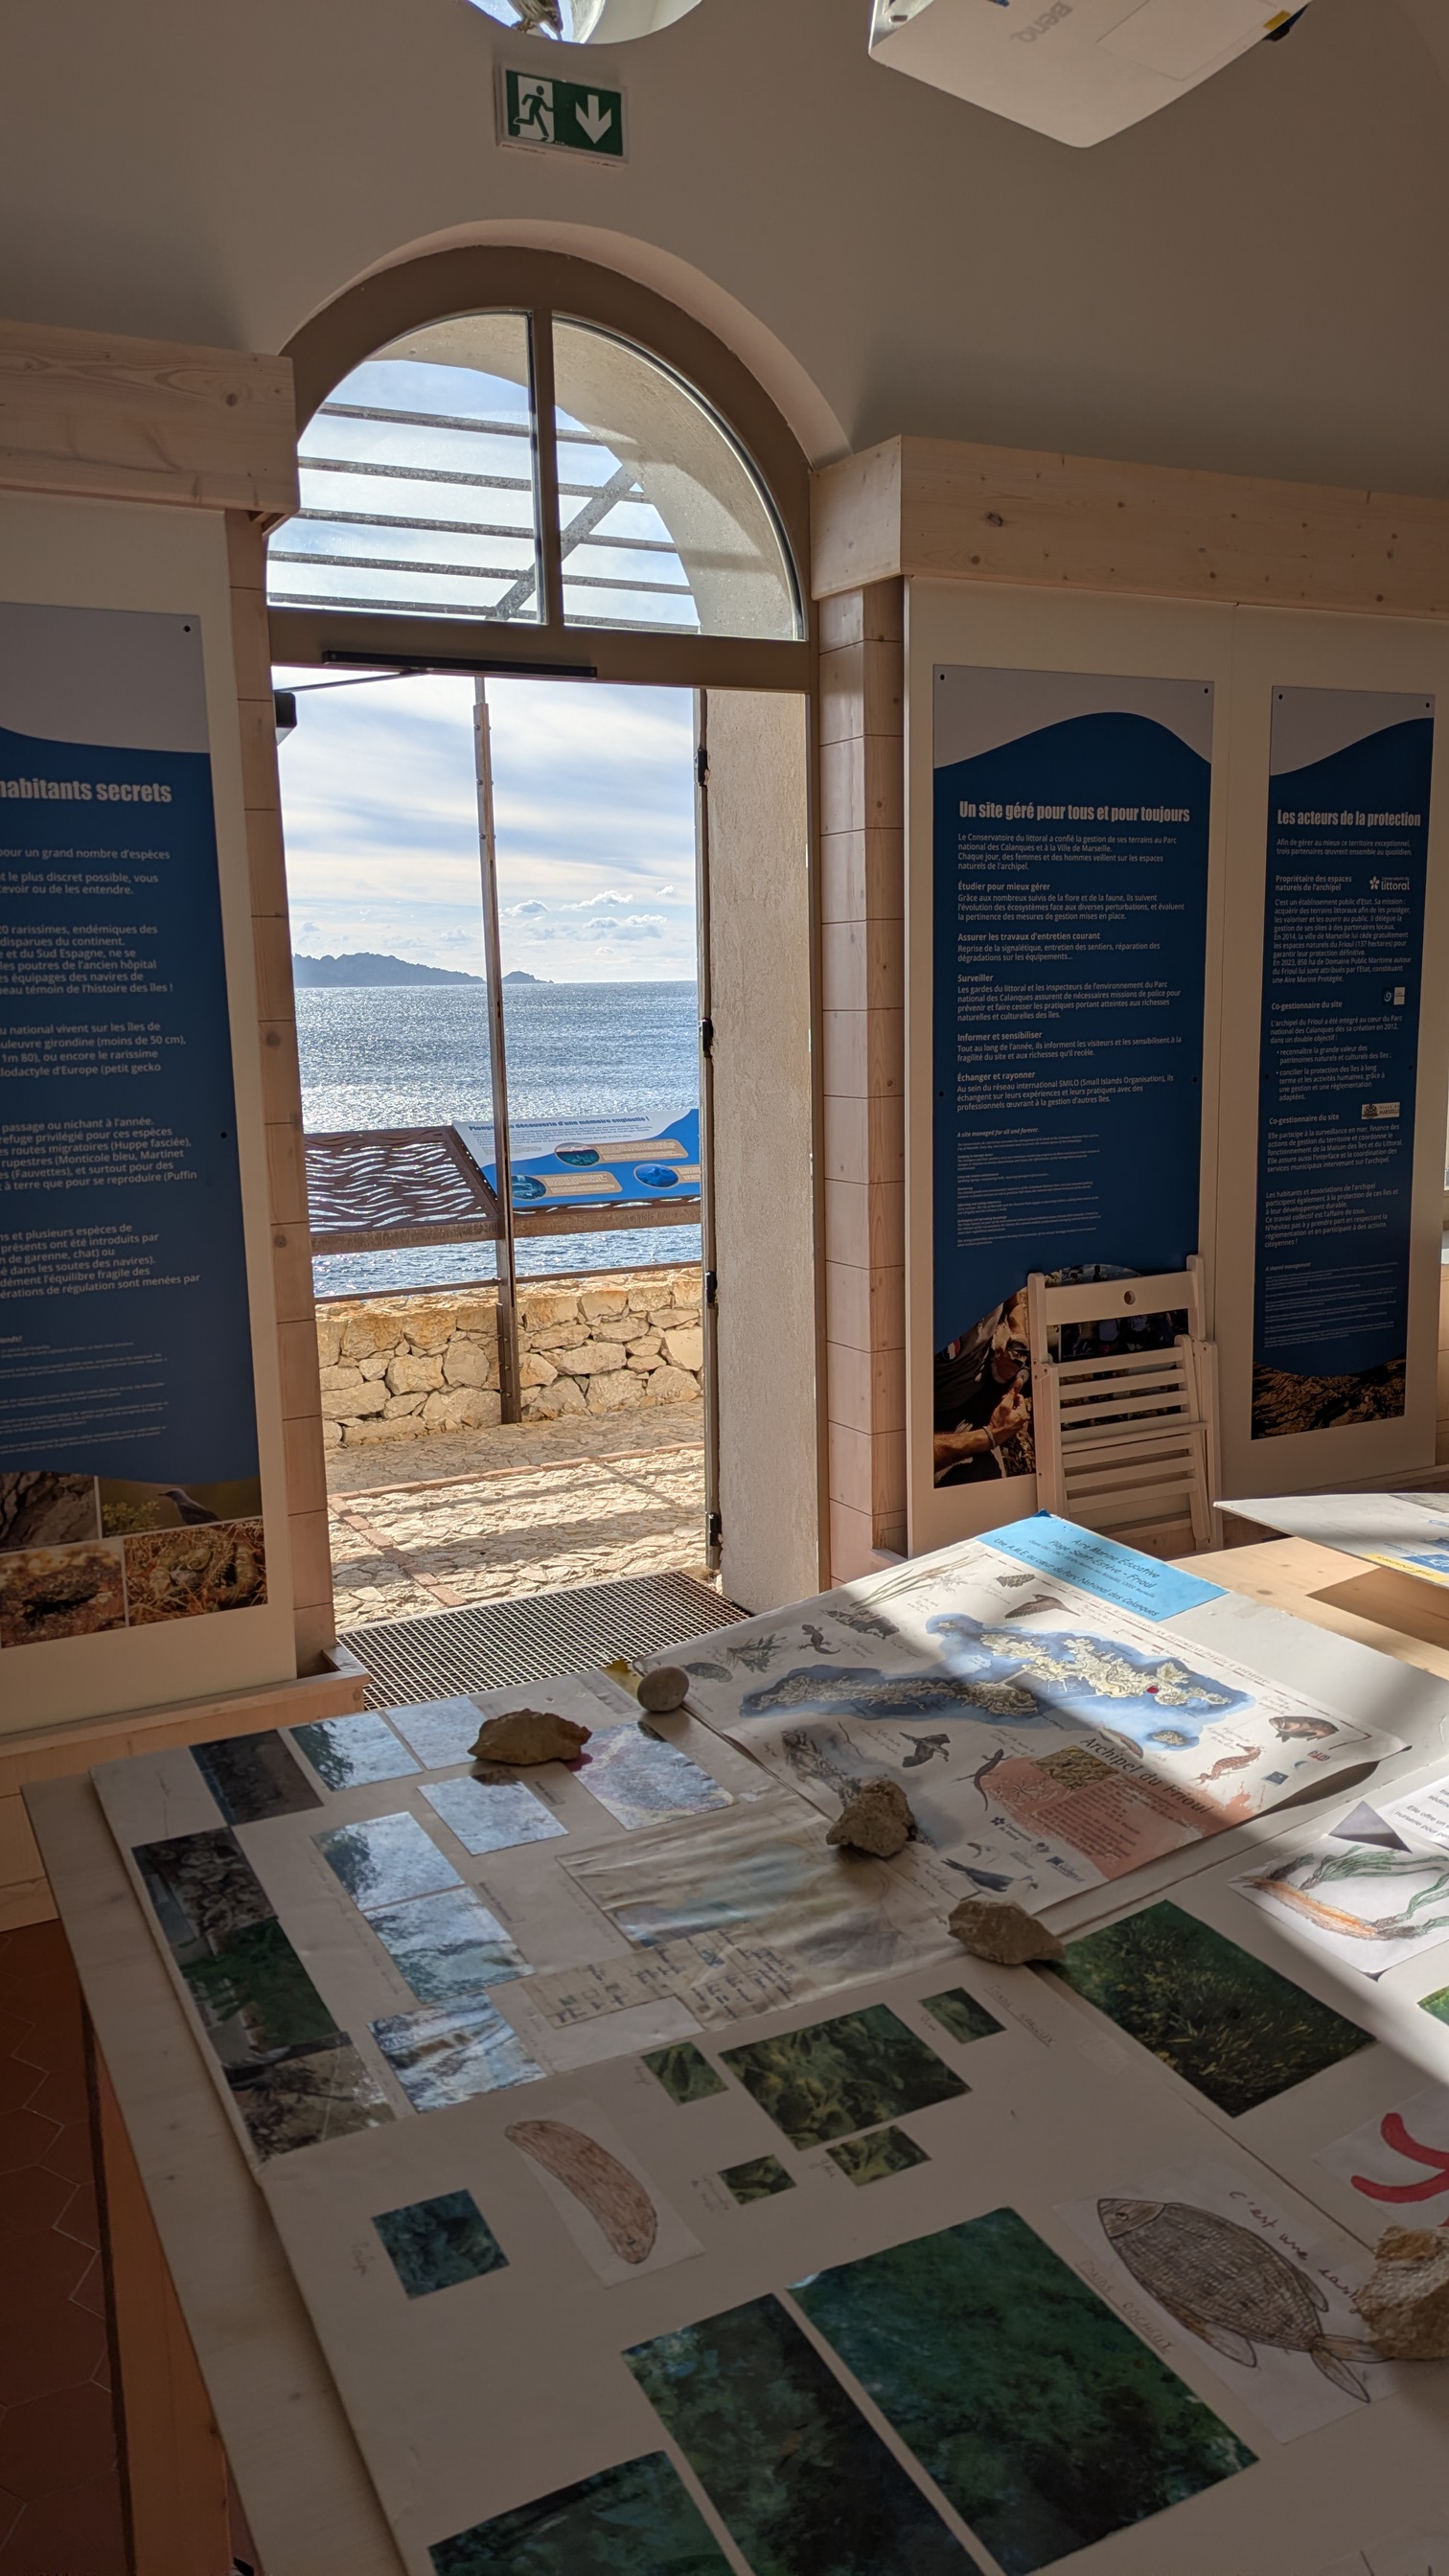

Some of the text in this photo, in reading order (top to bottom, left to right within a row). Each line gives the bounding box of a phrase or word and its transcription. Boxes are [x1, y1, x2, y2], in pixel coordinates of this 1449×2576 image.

[95, 783, 172, 802] secrets
[959, 801, 1190, 823] Un site géré pour tous et pour toujours
[1277, 809, 1421, 827] Les acteurs de la protection
[967, 833, 1015, 841] Conservatoire
[1025, 834, 1048, 842] littoral
[1054, 834, 1074, 842] confié
[1082, 835, 1106, 844] gestion
[1107, 835, 1116, 843] de
[41, 847, 74, 860] grand
[76, 848, 118, 859] nombre
[120, 848, 171, 862] d'espèces
[8, 871, 159, 885] le plus discret possible, vous
[1276, 874, 1352, 885] Propriétaire des espaces
[957, 880, 1050, 892] Étudier pour mieux gérer
[1275, 883, 1341, 892] naturels de l'archipel
[1381, 880, 1410, 890] littoral
[11, 924, 70, 934] rarissimes,
[72, 924, 137, 936] endémiques
[139, 924, 158, 934] des
[957, 932, 987, 941] Assurer
[988, 932, 999, 941] les
[1030, 932, 1071, 940] d'entretien
[1071, 932, 1100, 940] courant
[55, 936, 70, 946] du
[71, 936, 126, 946] continent.
[17, 961, 60, 973] poutres
[61, 960, 76, 970] de
[78, 959, 118, 970] l'ancien
[120, 959, 157, 971] hôpital
[957, 973, 994, 982] Surveiller
[25, 984, 64, 995] témoin
[65, 983, 80, 994] de
[81, 983, 127, 993] l'histoire
[128, 982, 148, 993] des
[149, 982, 168, 992] îles
[1271, 1000, 1321, 1012] Co-gestionnaire
[957, 1030, 1043, 1042] Informer et sensibiliser
[956, 1071, 991, 1083] Échanger
[1001, 1071, 1036, 1081] rayonner
[1, 1122, 45, 1135] passage
[63, 1118, 104, 1129] nichant
[113, 1116, 154, 1127] l'année.
[1269, 1115, 1318, 1126] Co-gestionnaire
[1327, 1113, 1340, 1121] site
[1048, 1540, 1070, 1551] Plage
[1069, 1550, 1122, 1574] Saint-Estève
[1126, 1574, 1158, 1589] Frioul
[1071, 1539, 1091, 1549] Aire
[1090, 1547, 1119, 1560] Marine
[1117, 1558, 1161, 1578] Éducative
[994, 1538, 1007, 1547] Une
[1063, 1570, 1080, 1580] Parc
[1077, 1577, 1112, 1594] National
[1108, 1589, 1124, 1599] des
[1122, 1598, 1161, 1617] Calanques
[1080, 1737, 1213, 1814] Archipel du Frioul
[1407, 1805, 1420, 1813] Elle
[1279, 2234, 1307, 2261] une
